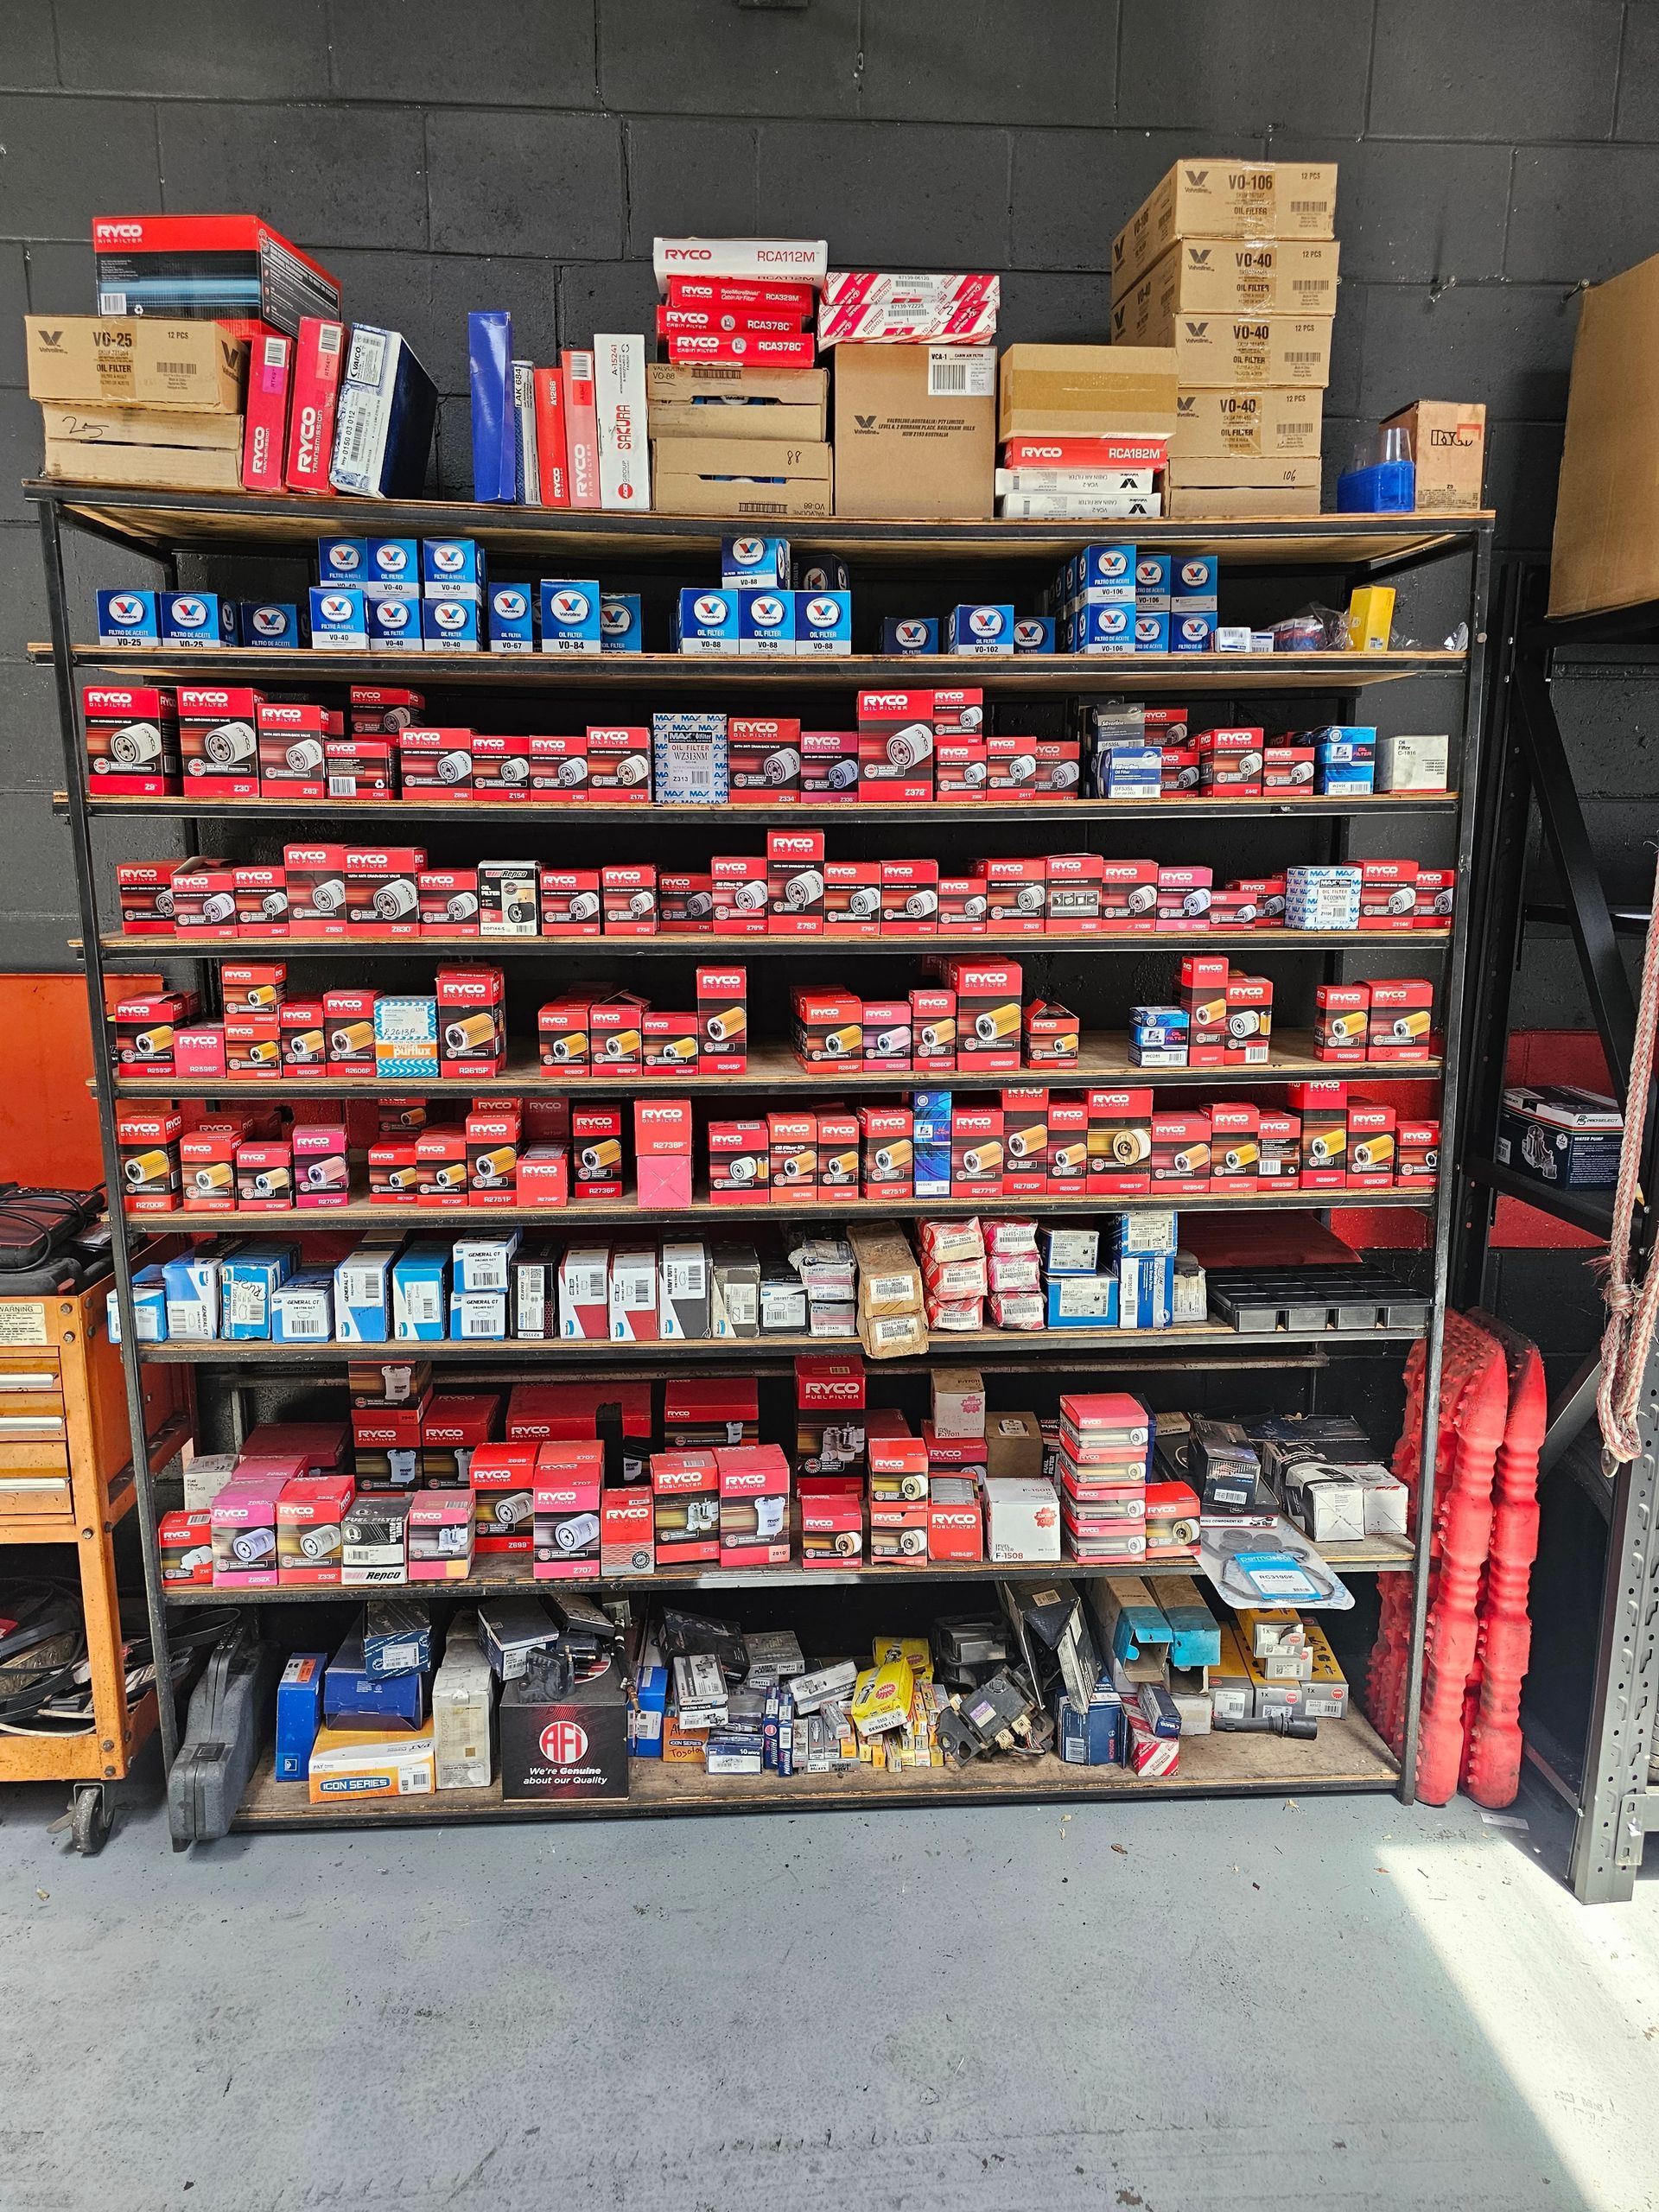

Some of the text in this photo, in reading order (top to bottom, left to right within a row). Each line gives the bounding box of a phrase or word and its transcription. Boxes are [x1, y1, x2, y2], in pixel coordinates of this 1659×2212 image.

[1229, 175, 1272, 189] VO-106
[97, 225, 143, 238] RYCO
[664, 250, 815, 262] RYCO RCA112M
[1236, 253, 1271, 267] VO-40
[682, 286, 712, 295] RYCO
[666, 312, 790, 330] RYCO RCA378C
[1234, 326, 1268, 339] VO-40
[92, 332, 132, 347] VO-25
[677, 337, 801, 351] RYCO RCA378C
[1220, 399, 1255, 412] VO-40
[62, 416, 109, 438] 25
[616, 404, 631, 449] SAKURA
[297, 407, 315, 473] RYCO
[253, 427, 264, 474] RYCO
[1021, 447, 1062, 457] RYCO
[1109, 448, 1160, 458] RCA182M
[575, 443, 588, 497] RYCO
[1283, 470, 1295, 480] 106
[558, 641, 584, 650] VO-84
[88, 691, 132, 702] RYCO
[182, 691, 228, 702] RYCO
[863, 695, 907, 705] RYCO
[262, 709, 301, 718] RYCO
[734, 721, 779, 733] RYCO
[590, 730, 628, 741] RYCO
[1217, 733, 1252, 741] RYCO
[804, 736, 840, 746] RYCO
[773, 838, 814, 849] RYCO
[347, 855, 387, 864] RYCO
[121, 869, 157, 878] RYCO
[1161, 872, 1192, 880] RYCO
[965, 973, 1007, 983] RYCO
[443, 984, 486, 994] RYCO
[1230, 988, 1263, 996] RYCO
[179, 1036, 217, 1046] RYCO
[1093, 1095, 1129, 1103] RYCO
[642, 1109, 682, 1119] RYCO
[120, 1124, 160, 1133] RYCO
[806, 1383, 859, 1393] RYCO
[474, 1470, 511, 1478] RYCO
[932, 1515, 976, 1524] RYCO
[365, 1572, 400, 1580] Repco
[323, 1778, 388, 1790] ICON SERIES
[574, 1776, 607, 1786] Quality
